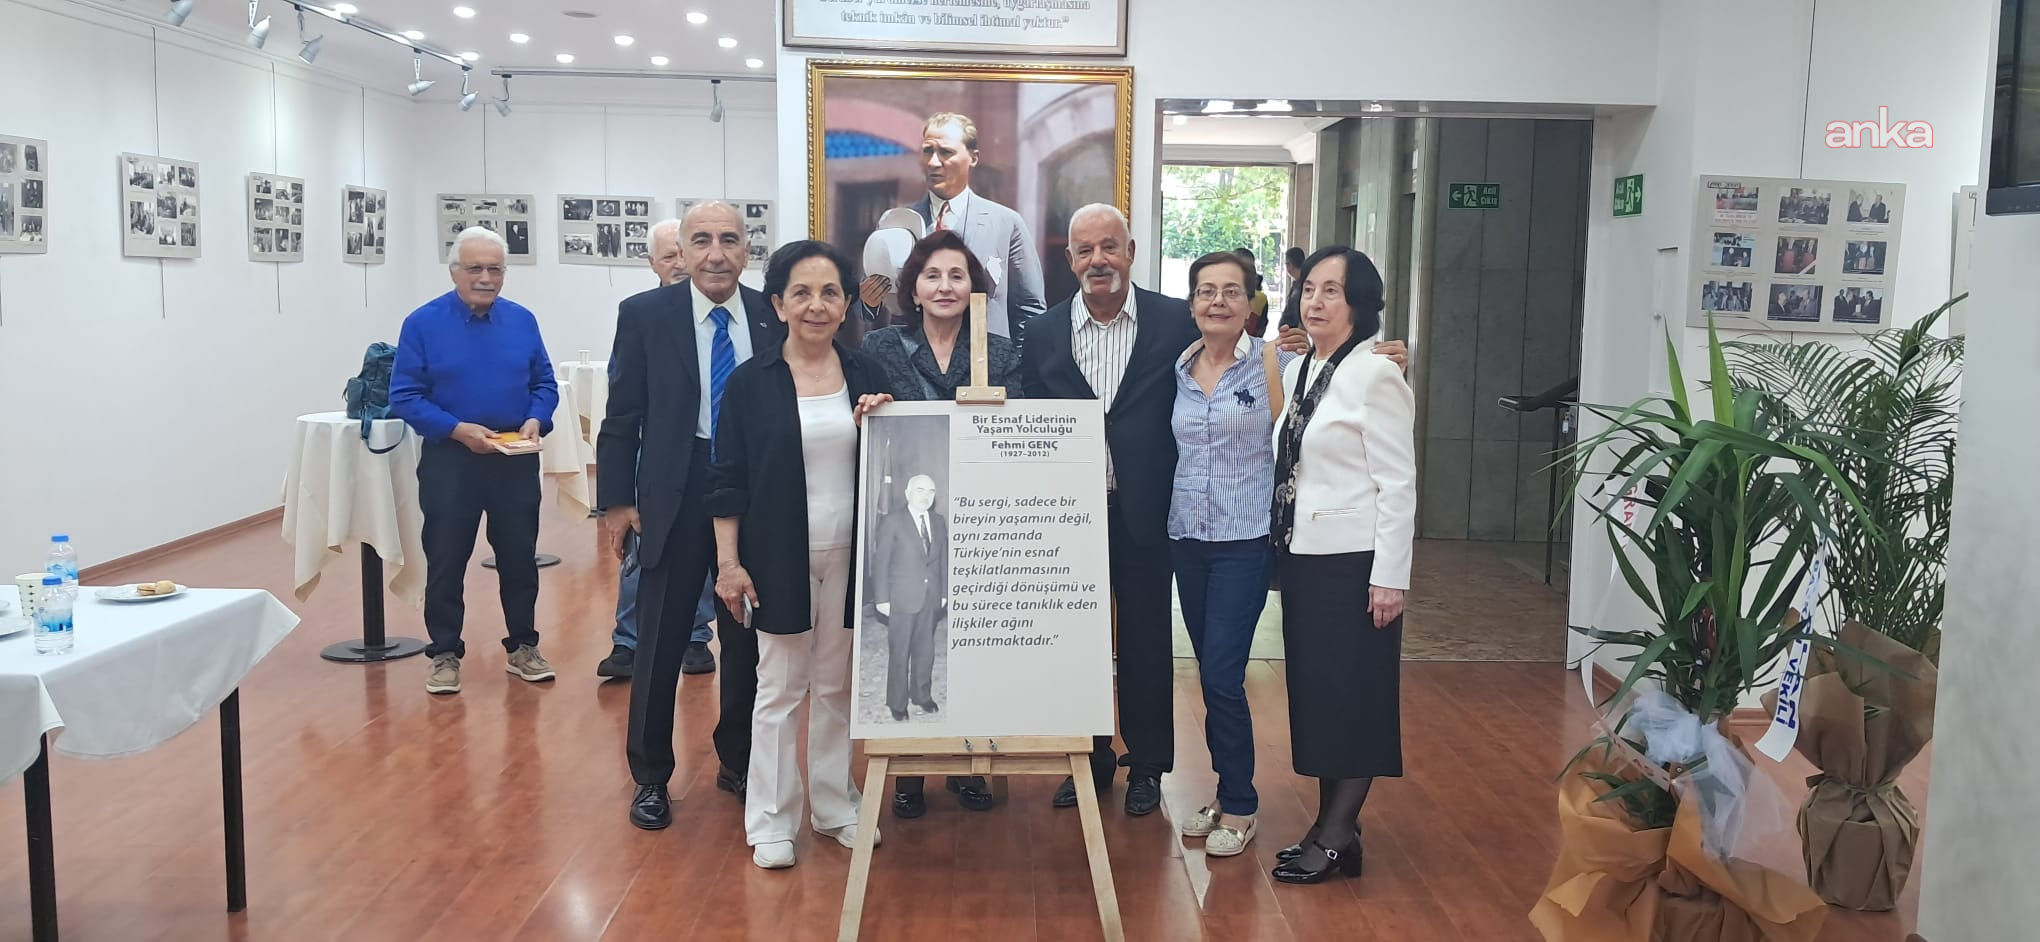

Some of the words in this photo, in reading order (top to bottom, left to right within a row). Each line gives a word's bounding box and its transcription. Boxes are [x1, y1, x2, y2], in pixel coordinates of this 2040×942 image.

[839, 9, 877, 22] teknik
[918, 15, 932, 25] ve
[933, 12, 978, 26] bilimsel
[980, 14, 1020, 28] ihtimal
[973, 415, 988, 424] Bir
[992, 415, 1023, 424] Esnaf
[1026, 415, 1076, 423] Liderinin
[977, 425, 1013, 435] Yaşam
[1016, 425, 1072, 435] Yolculuğu
[992, 441, 1025, 449] Fehmi
[1028, 441, 1058, 451] GENÇ
[978, 497, 1012, 509] sergi,
[1015, 496, 1056, 506] sadece
[1060, 496, 1076, 506] bir
[953, 514, 995, 526] bireyin
[999, 515, 1055, 525] yaşamını
[1059, 513, 1092, 525] değil,
[953, 532, 980, 543] aynı
[983, 531, 1042, 540] zamanda
[1025, 547, 1060, 558] esnaf
[953, 565, 1070, 577] teşkilatlanmasının
[952, 582, 1008, 595] geçirdiği
[1011, 582, 1078, 594] dönüşümü
[1082, 584, 1096, 592] ve
[953, 601, 968, 610] bu
[972, 601, 1012, 610] sürece
[1016, 599, 1063, 610] tanıklık
[1067, 599, 1097, 609] eden
[952, 618, 998, 631] ilişkiler
[1001, 618, 1033, 630] ağını
